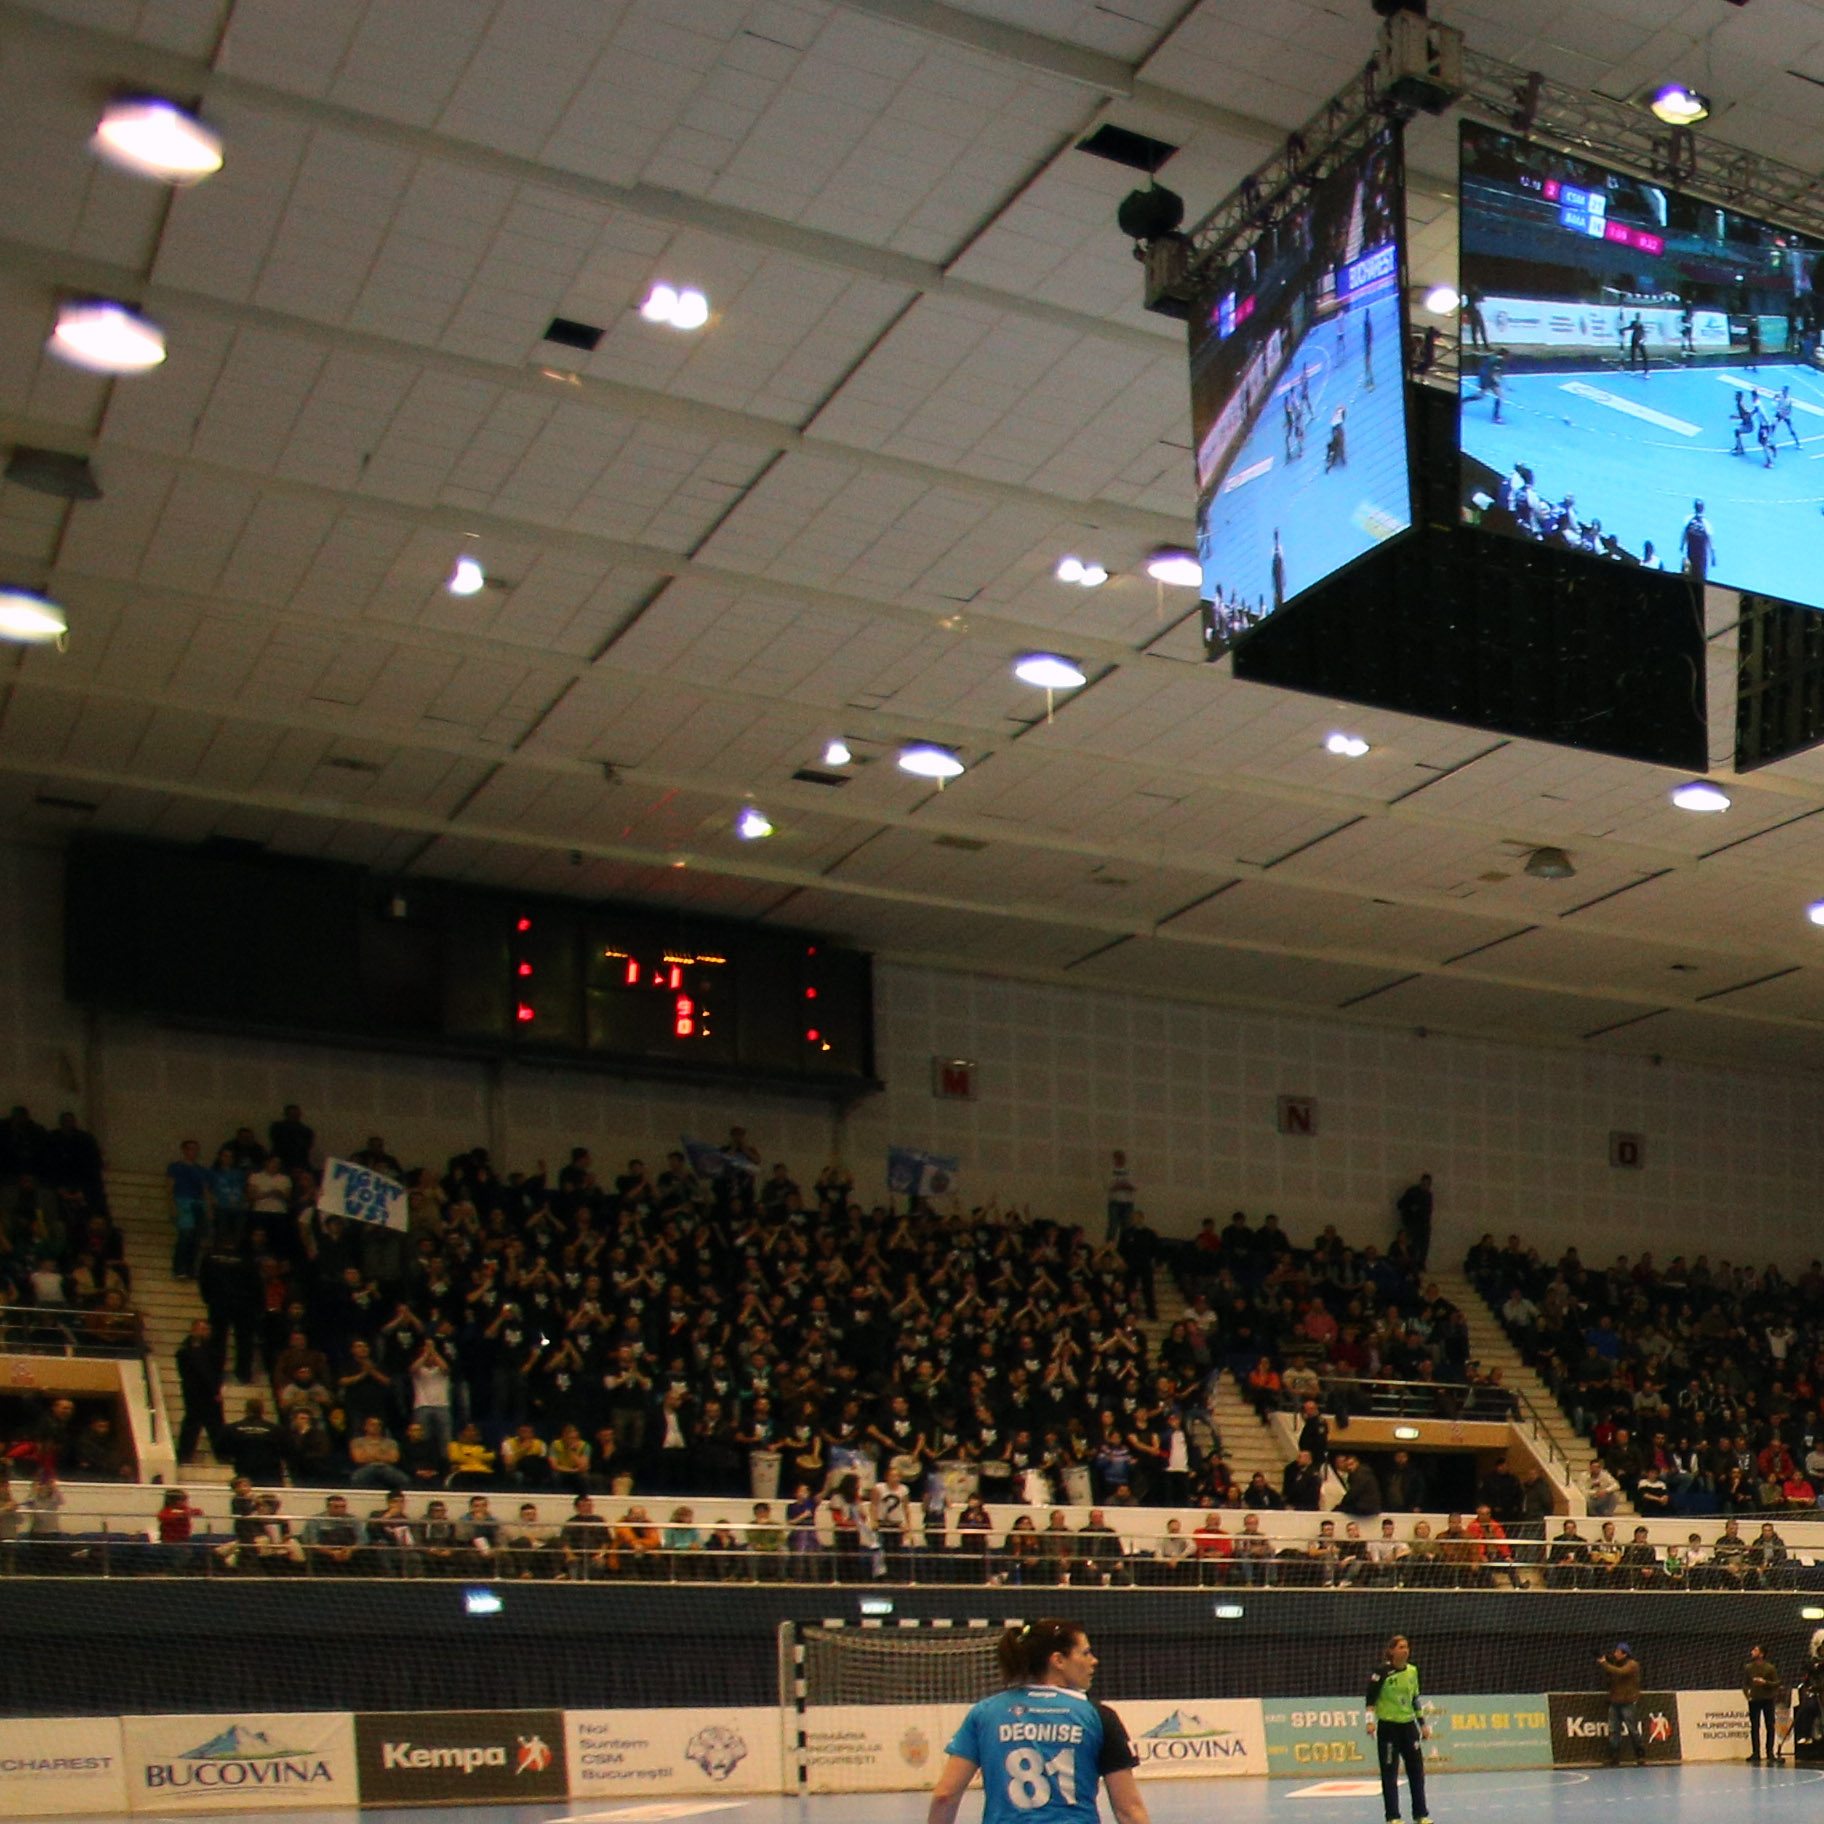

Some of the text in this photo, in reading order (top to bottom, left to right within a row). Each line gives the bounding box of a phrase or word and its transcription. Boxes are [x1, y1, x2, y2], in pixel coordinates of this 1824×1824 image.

[944, 1069, 968, 1096] M
[1287, 1105, 1309, 1131] N
[1290, 1710, 1361, 1728] SPORT
[998, 1722, 1084, 1744] DEONISE
[382, 1742, 507, 1774] Kempa
[1136, 1738, 1247, 1762] UCOVINA
[1293, 1740, 1365, 1763] COOL
[145, 1760, 335, 1788] BUCOVINA
[1005, 1747, 1077, 1810] 81
